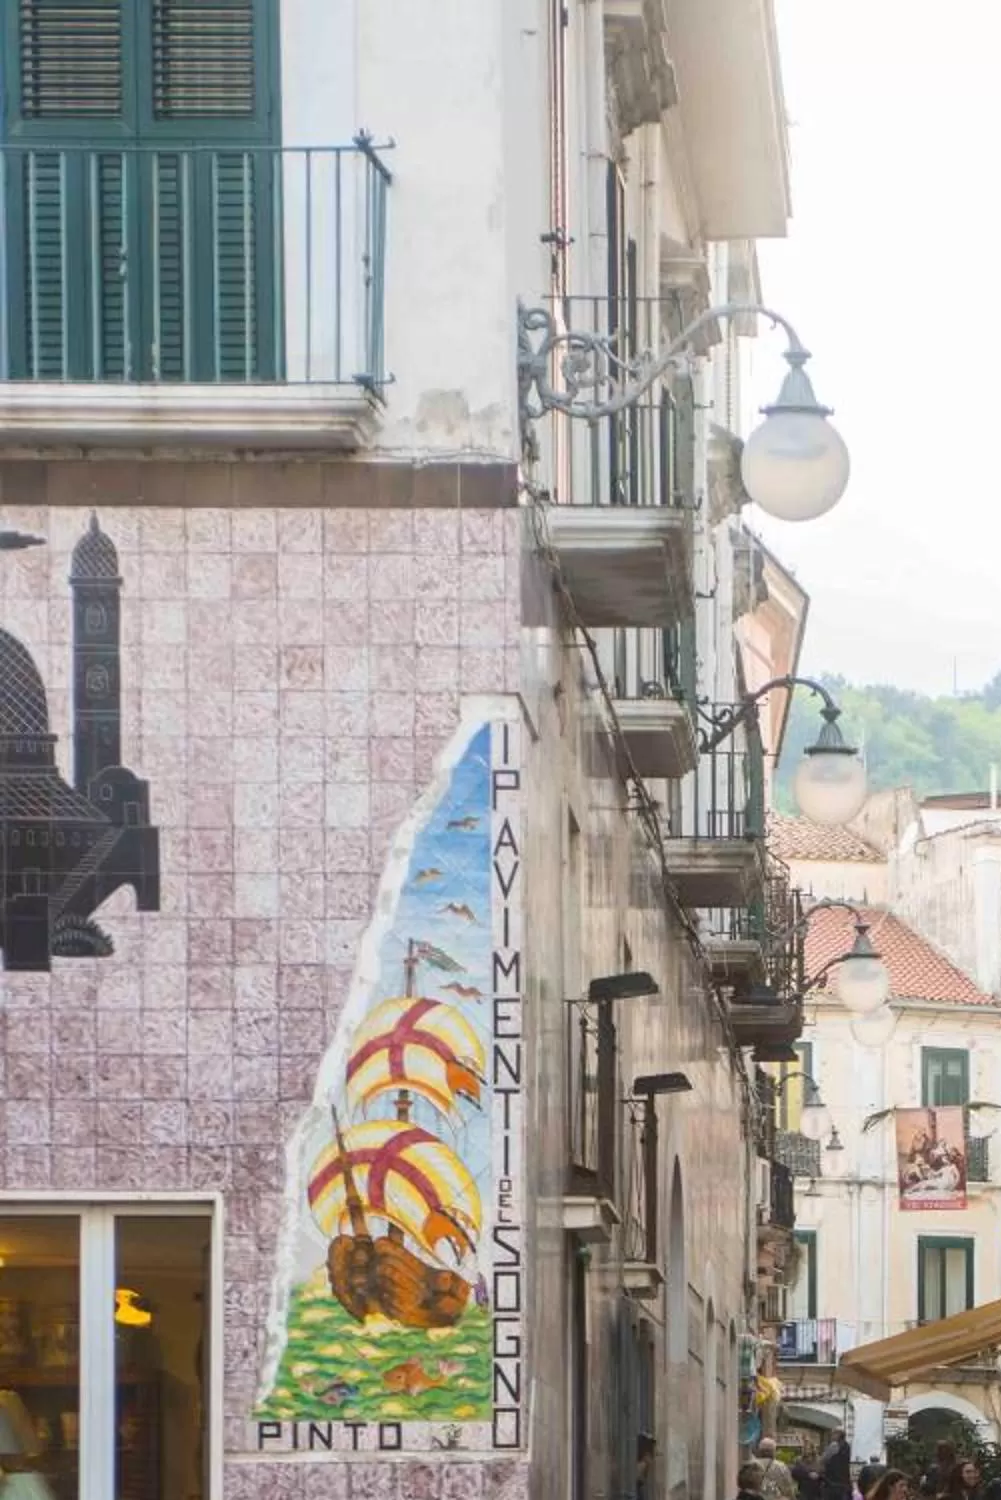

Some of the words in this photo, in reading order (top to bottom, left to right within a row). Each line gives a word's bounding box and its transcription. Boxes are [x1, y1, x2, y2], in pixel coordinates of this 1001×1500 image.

[492, 769, 521, 1176] PAVIMENTI
[498, 1179, 513, 1223] DEL
[492, 1225, 521, 1450] SOGNO
[257, 1421, 401, 1451] PINTO
